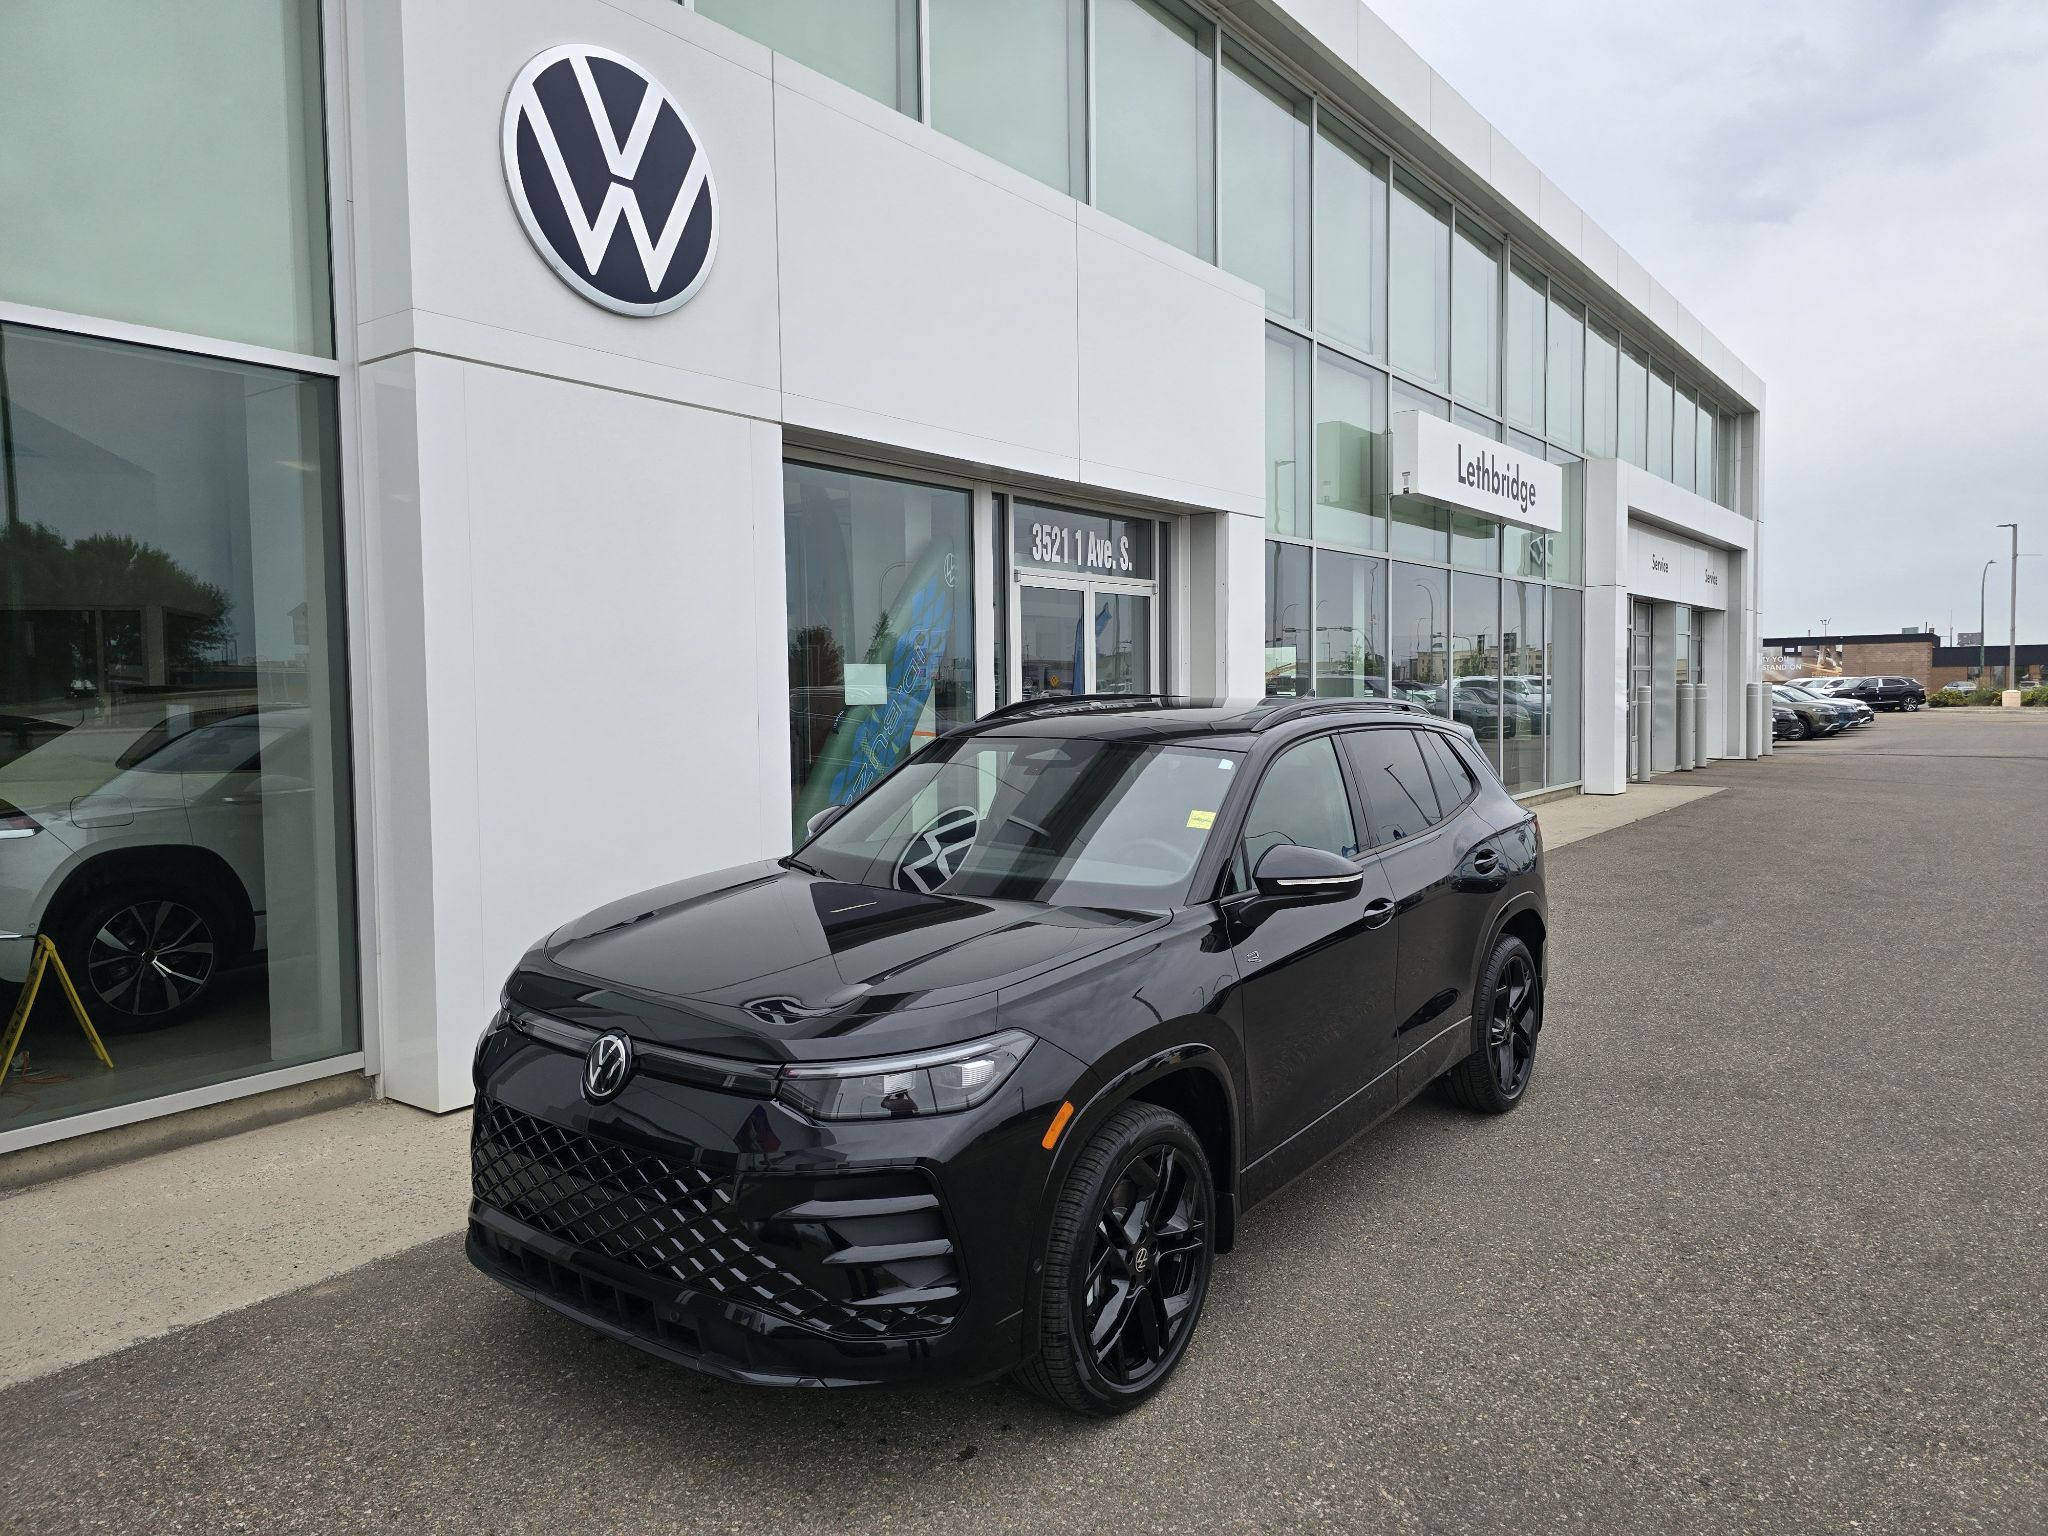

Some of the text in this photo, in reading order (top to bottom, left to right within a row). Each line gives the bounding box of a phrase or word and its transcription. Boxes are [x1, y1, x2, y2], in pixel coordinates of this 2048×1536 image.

[501, 44, 720, 317] VW
[1457, 443, 1537, 514] Lethbridge
[1032, 522, 1133, 571] 3521 1 Ave. S.
[1651, 553, 1669, 574] Service
[1704, 568, 1718, 586] Service
[1772, 655, 1789, 663] YOU
